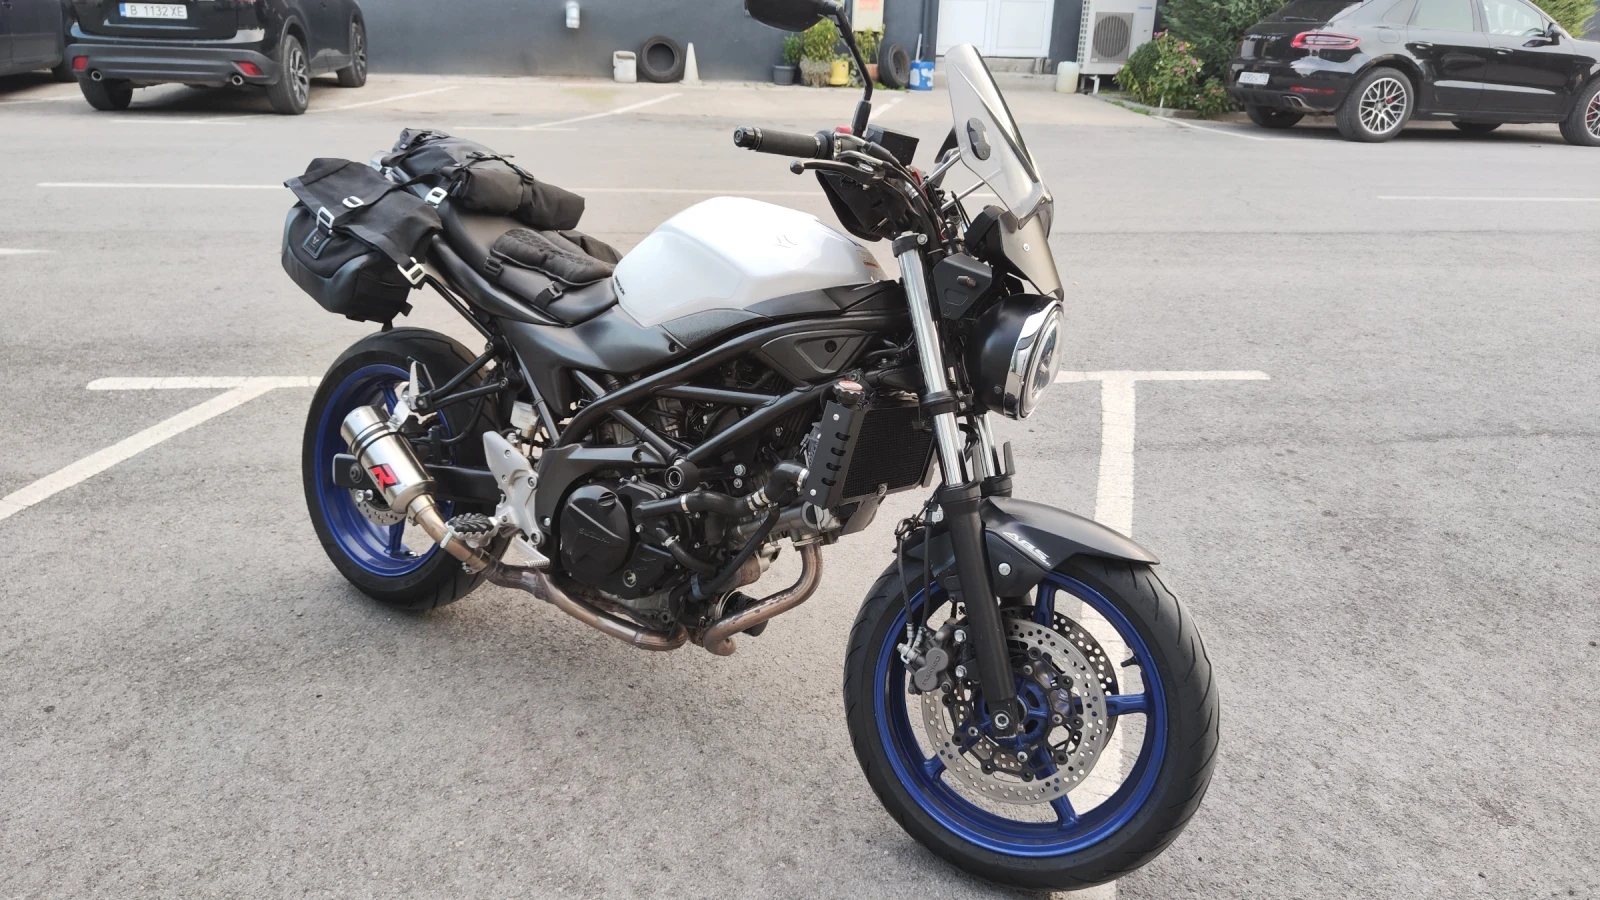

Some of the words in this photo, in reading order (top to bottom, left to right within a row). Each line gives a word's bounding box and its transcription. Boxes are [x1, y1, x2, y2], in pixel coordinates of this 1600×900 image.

[130, 5, 138, 16] B
[144, 5, 169, 17] 1132
[170, 6, 185, 17] XE
[1002, 531, 1051, 563] ABS
